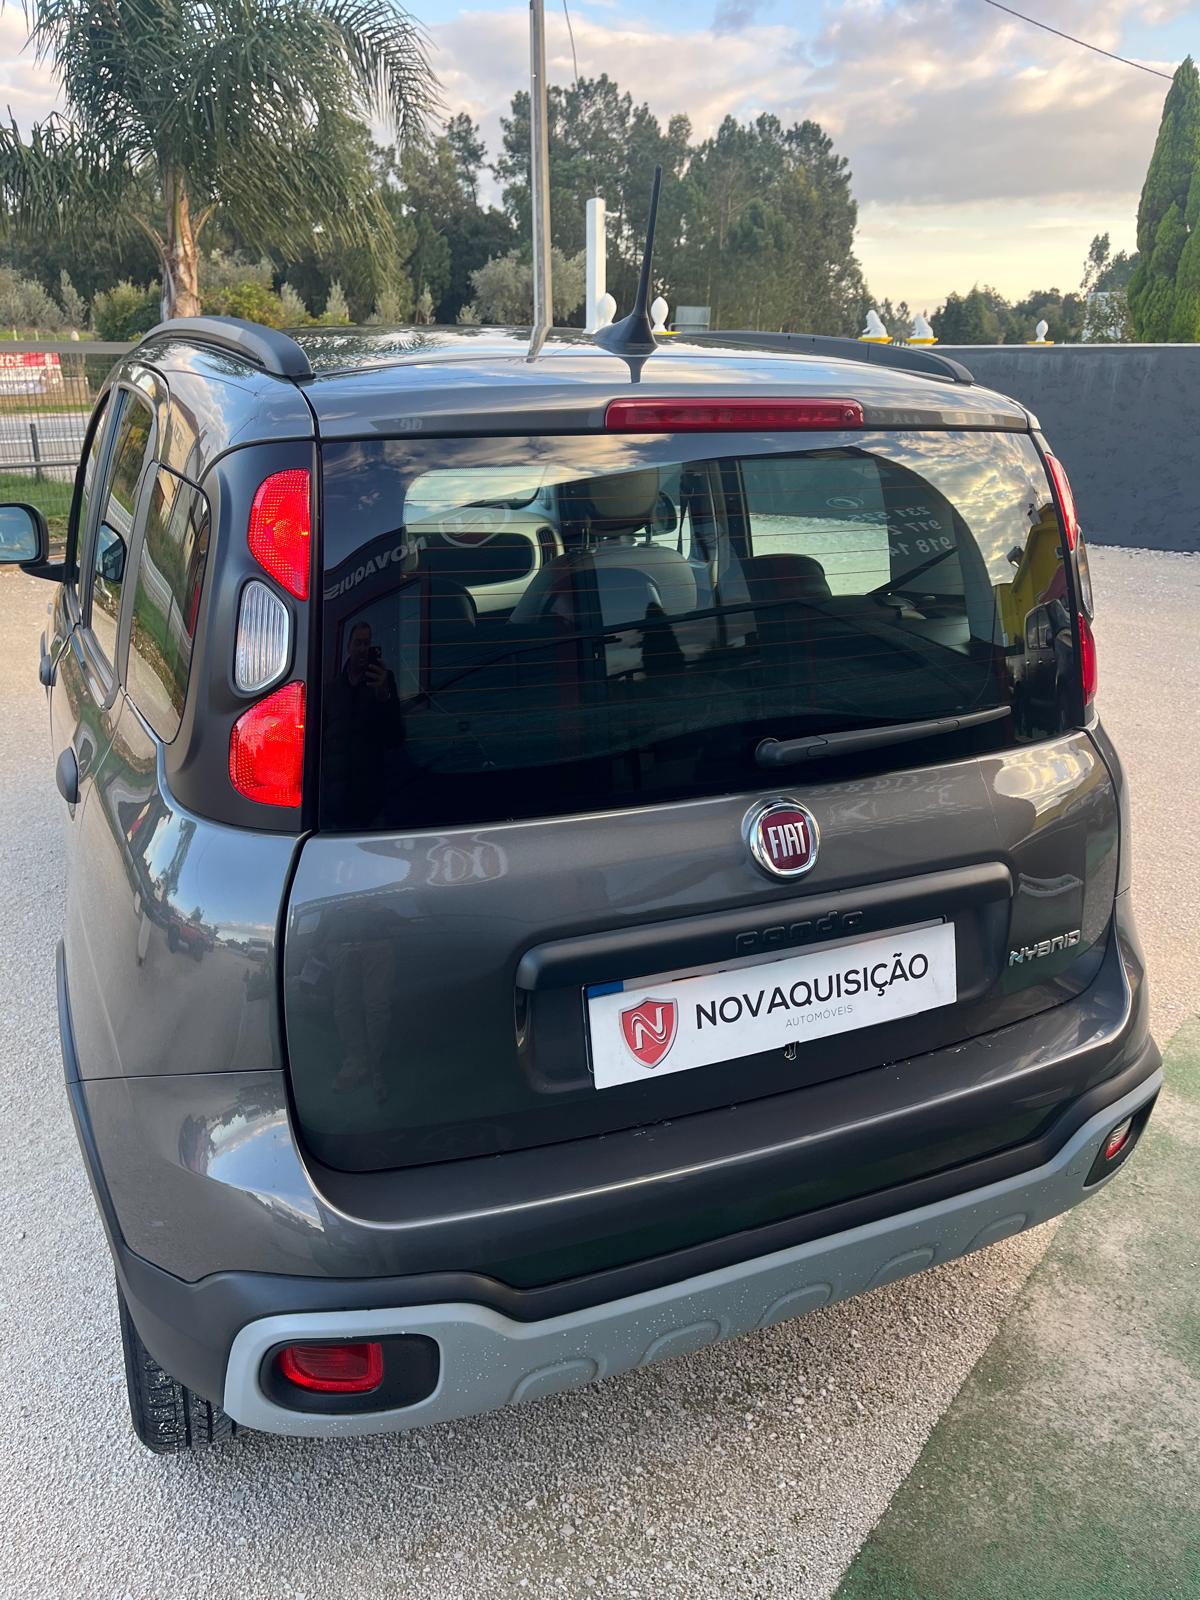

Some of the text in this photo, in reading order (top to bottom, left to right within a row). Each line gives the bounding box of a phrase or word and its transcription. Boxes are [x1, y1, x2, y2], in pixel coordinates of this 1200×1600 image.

[767, 821, 807, 859] FIAT
[1008, 929, 1080, 967] HYBRID
[696, 952, 929, 1030] NOVAQUISIÇÃO
[785, 1004, 854, 1028] AUTOMÓVEIS
